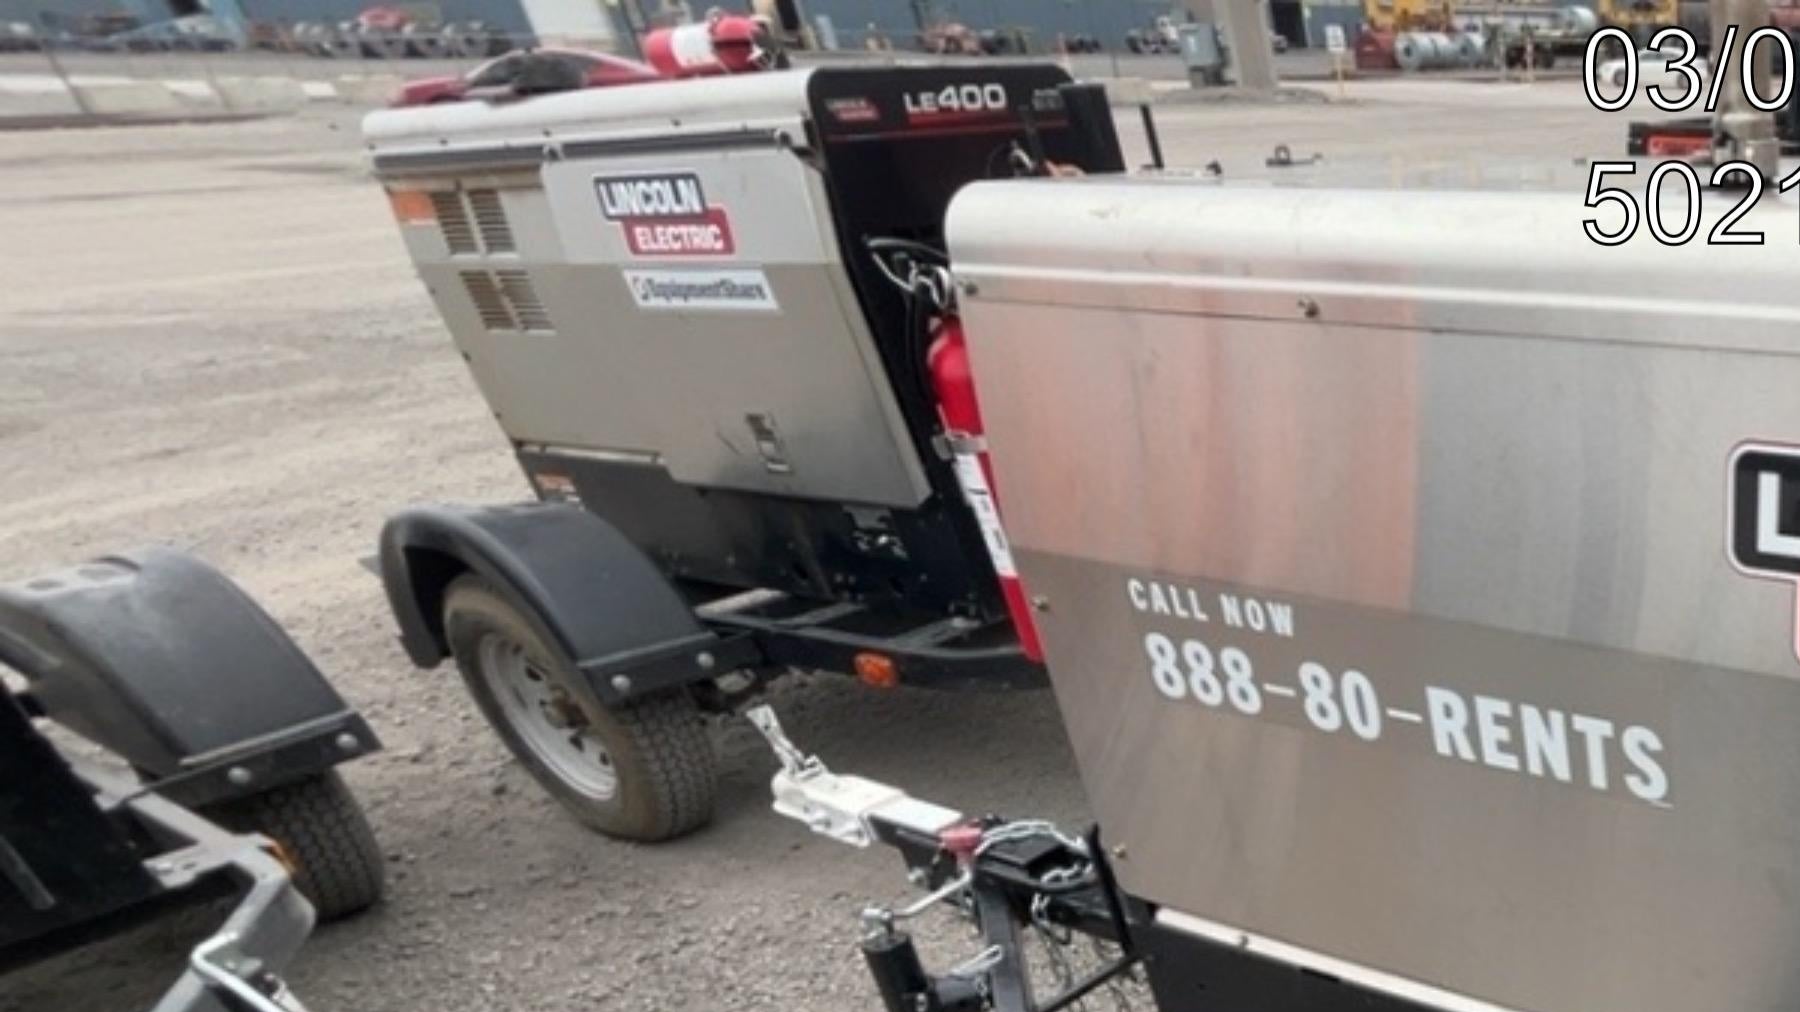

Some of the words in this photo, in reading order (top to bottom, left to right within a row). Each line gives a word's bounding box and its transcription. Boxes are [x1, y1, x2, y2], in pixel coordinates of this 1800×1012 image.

[903, 84, 1006, 114] LE400
[599, 178, 703, 216] LINCOLN
[634, 224, 724, 251] ELECTRIC
[1128, 578, 1209, 622] CALL
[1220, 593, 1294, 637] NOW
[1144, 632, 1670, 802] 888-80-RENTS
